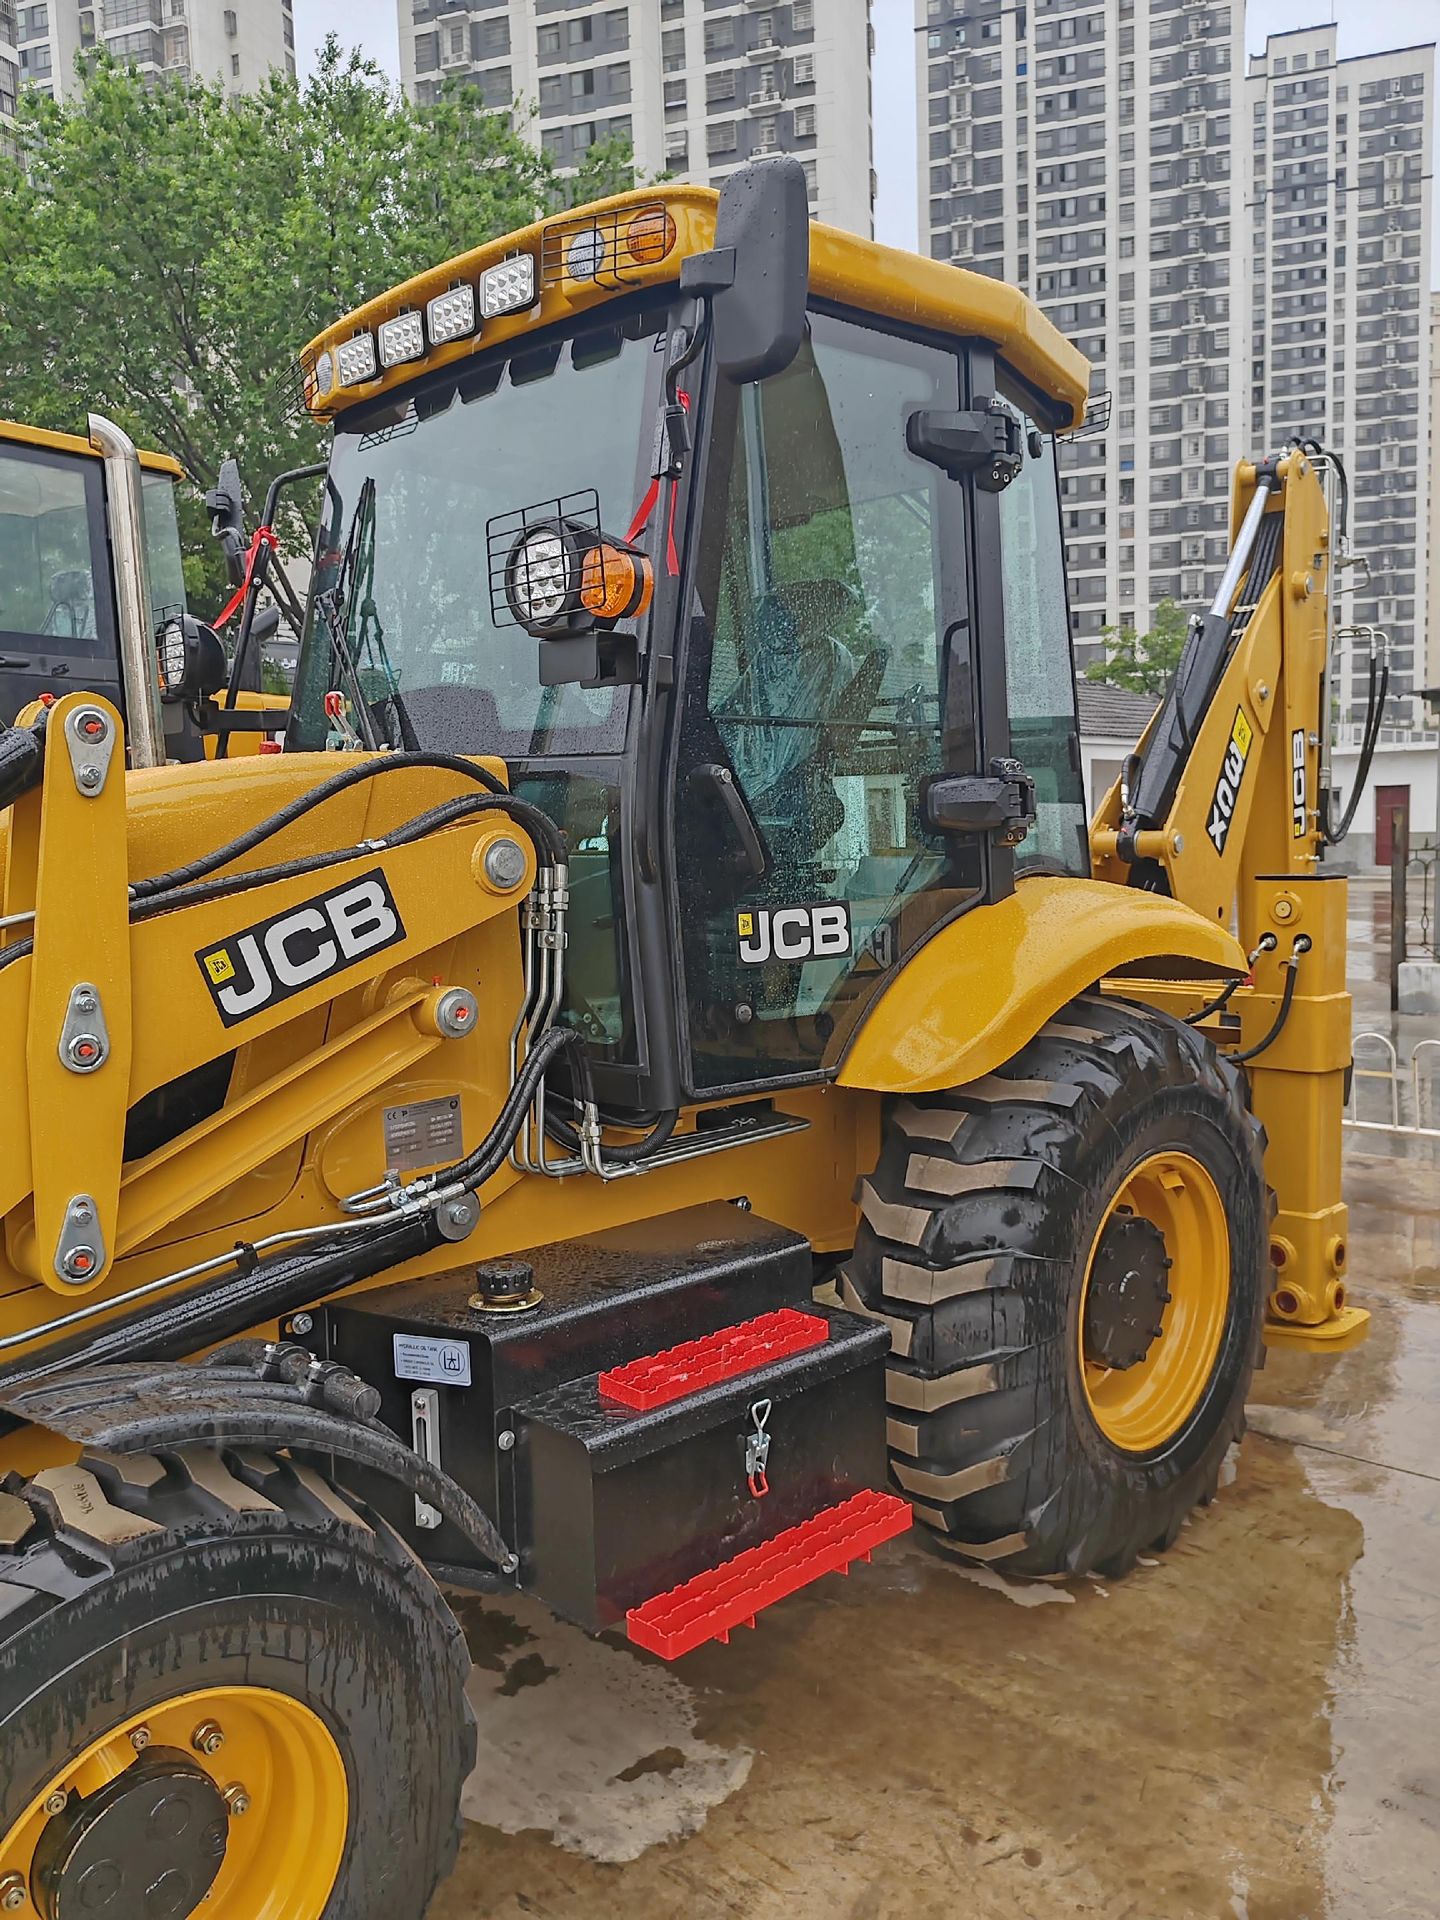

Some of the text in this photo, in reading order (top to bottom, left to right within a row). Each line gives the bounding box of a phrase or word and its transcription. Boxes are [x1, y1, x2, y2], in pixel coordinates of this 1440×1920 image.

[1207, 741, 1244, 851] 3DX
[1293, 731, 1305, 837] JCB
[217, 880, 397, 1015] JCB
[739, 906, 850, 963] JCB
